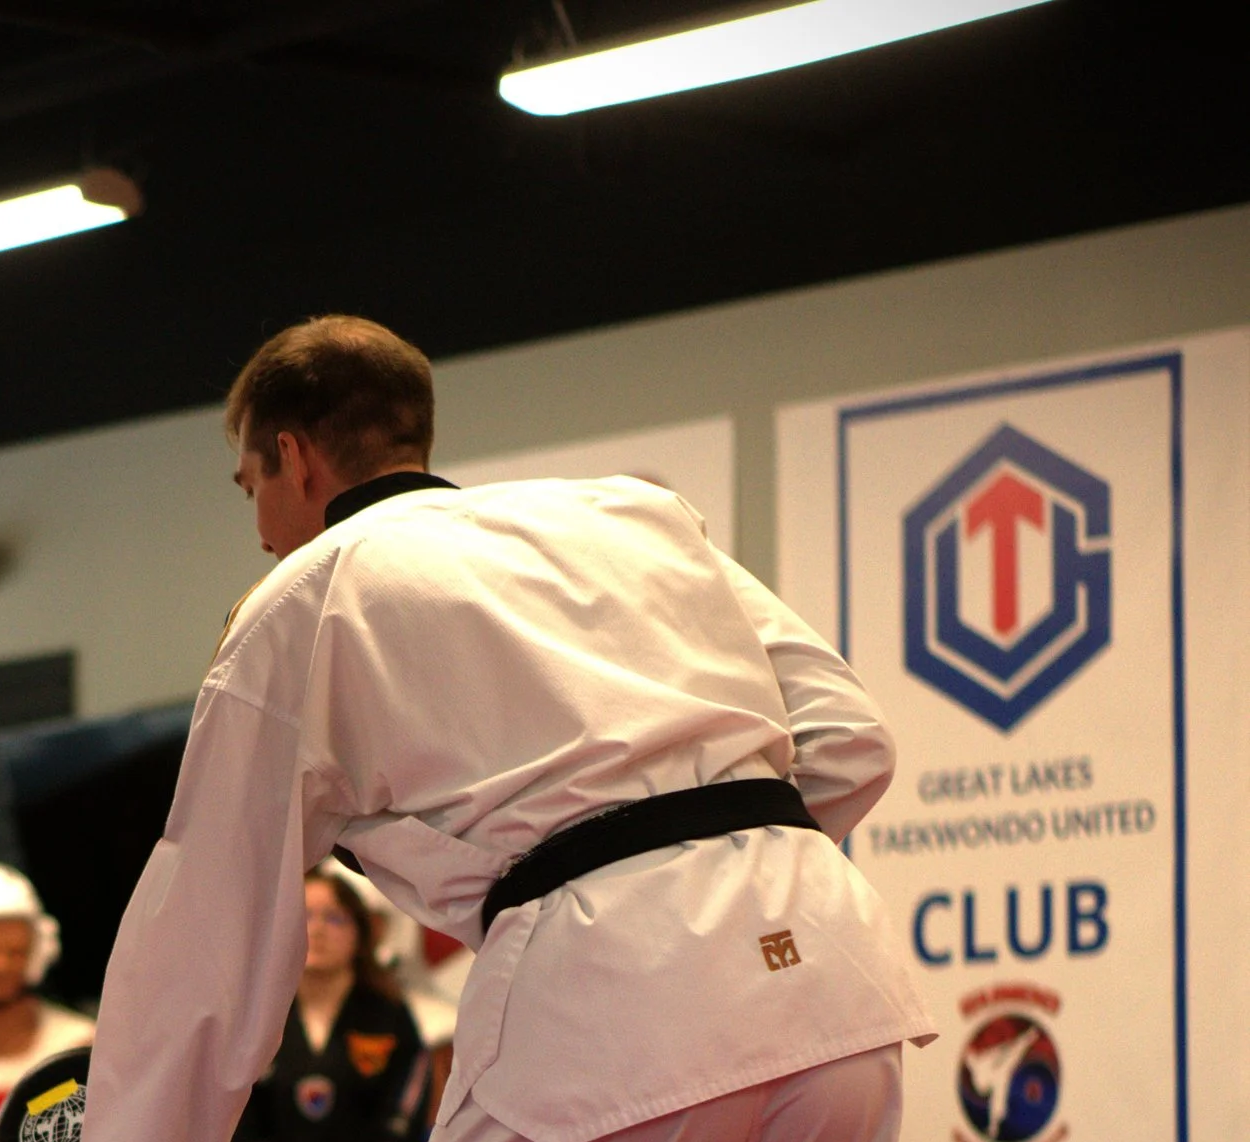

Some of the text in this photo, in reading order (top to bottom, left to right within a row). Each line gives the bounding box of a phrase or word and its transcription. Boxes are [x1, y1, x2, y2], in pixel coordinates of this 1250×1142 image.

[917, 756, 1093, 803] GREAT LAKES
[869, 799, 1155, 854] TAEKWONDO UNITED
[912, 880, 1110, 966] CLUB
